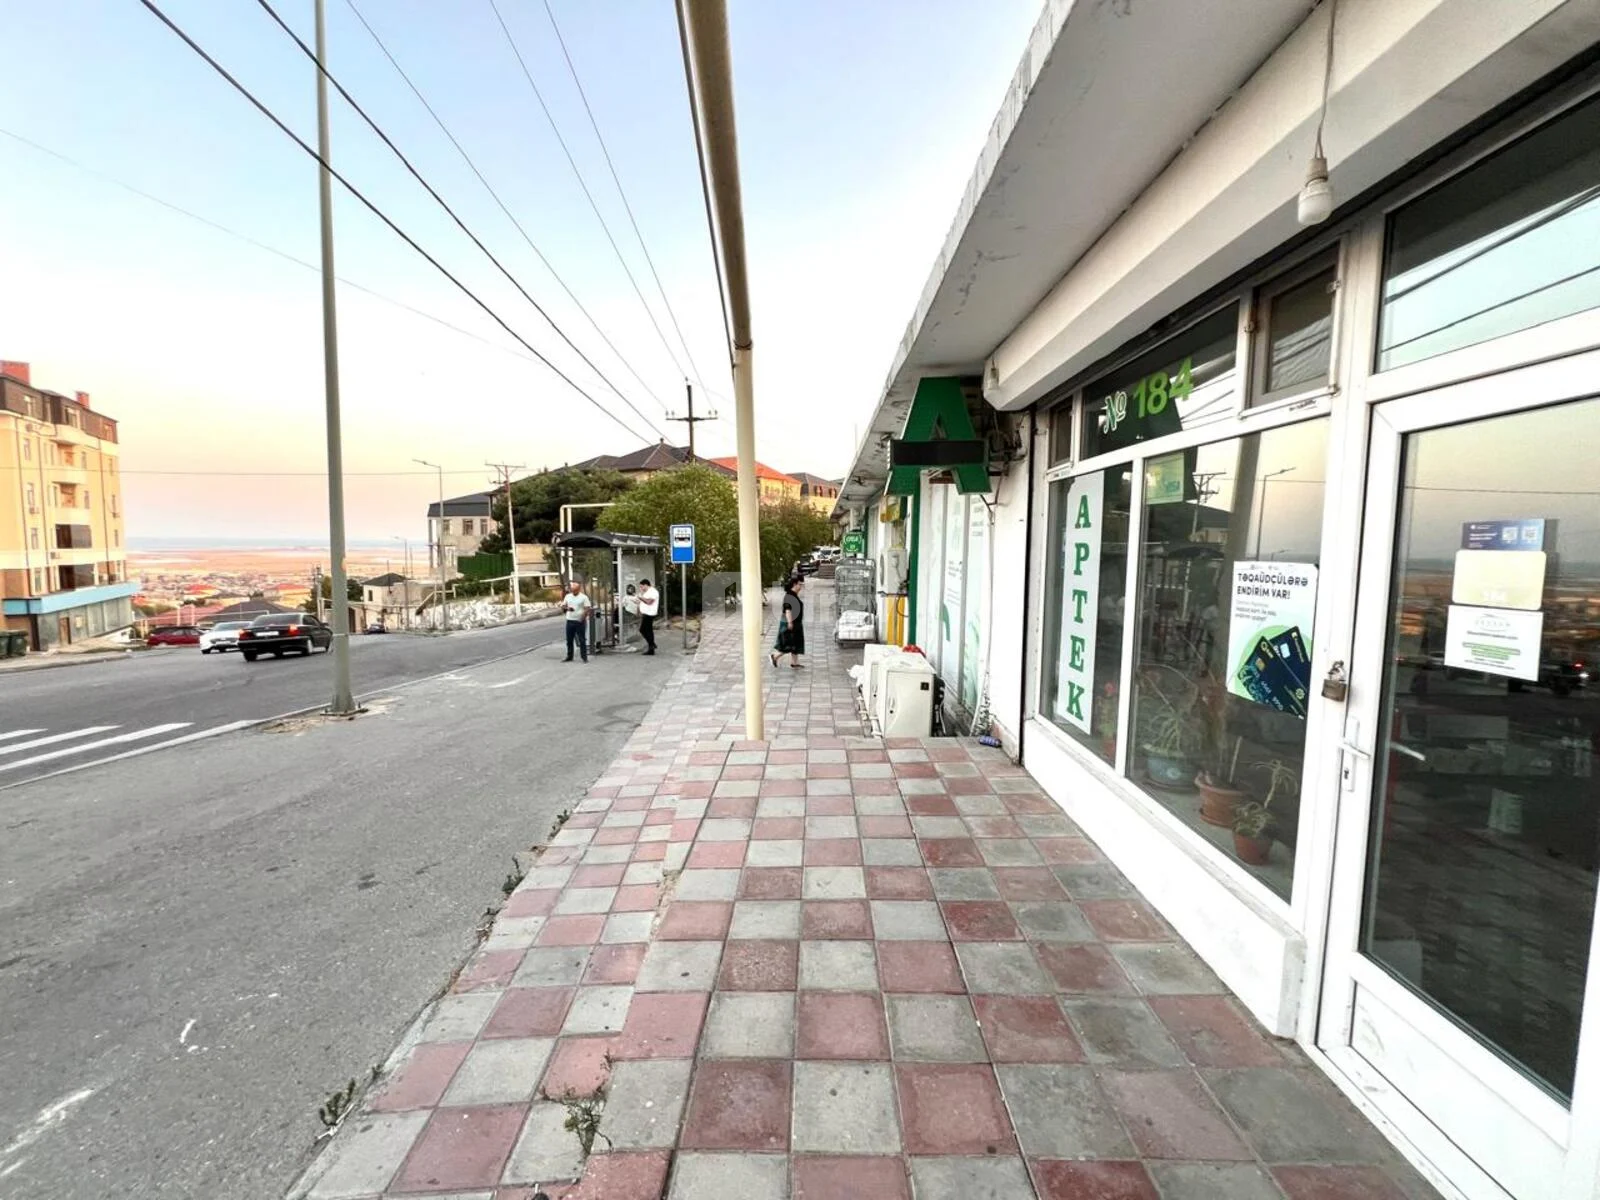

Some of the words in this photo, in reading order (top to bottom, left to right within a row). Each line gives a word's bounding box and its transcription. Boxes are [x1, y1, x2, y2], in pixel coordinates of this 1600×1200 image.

[1132, 356, 1194, 418] 184
[1066, 494, 1092, 722] APTEK
[1236, 585, 1270, 598] ENDİRİM
[1271, 588, 1291, 600] VAR!
